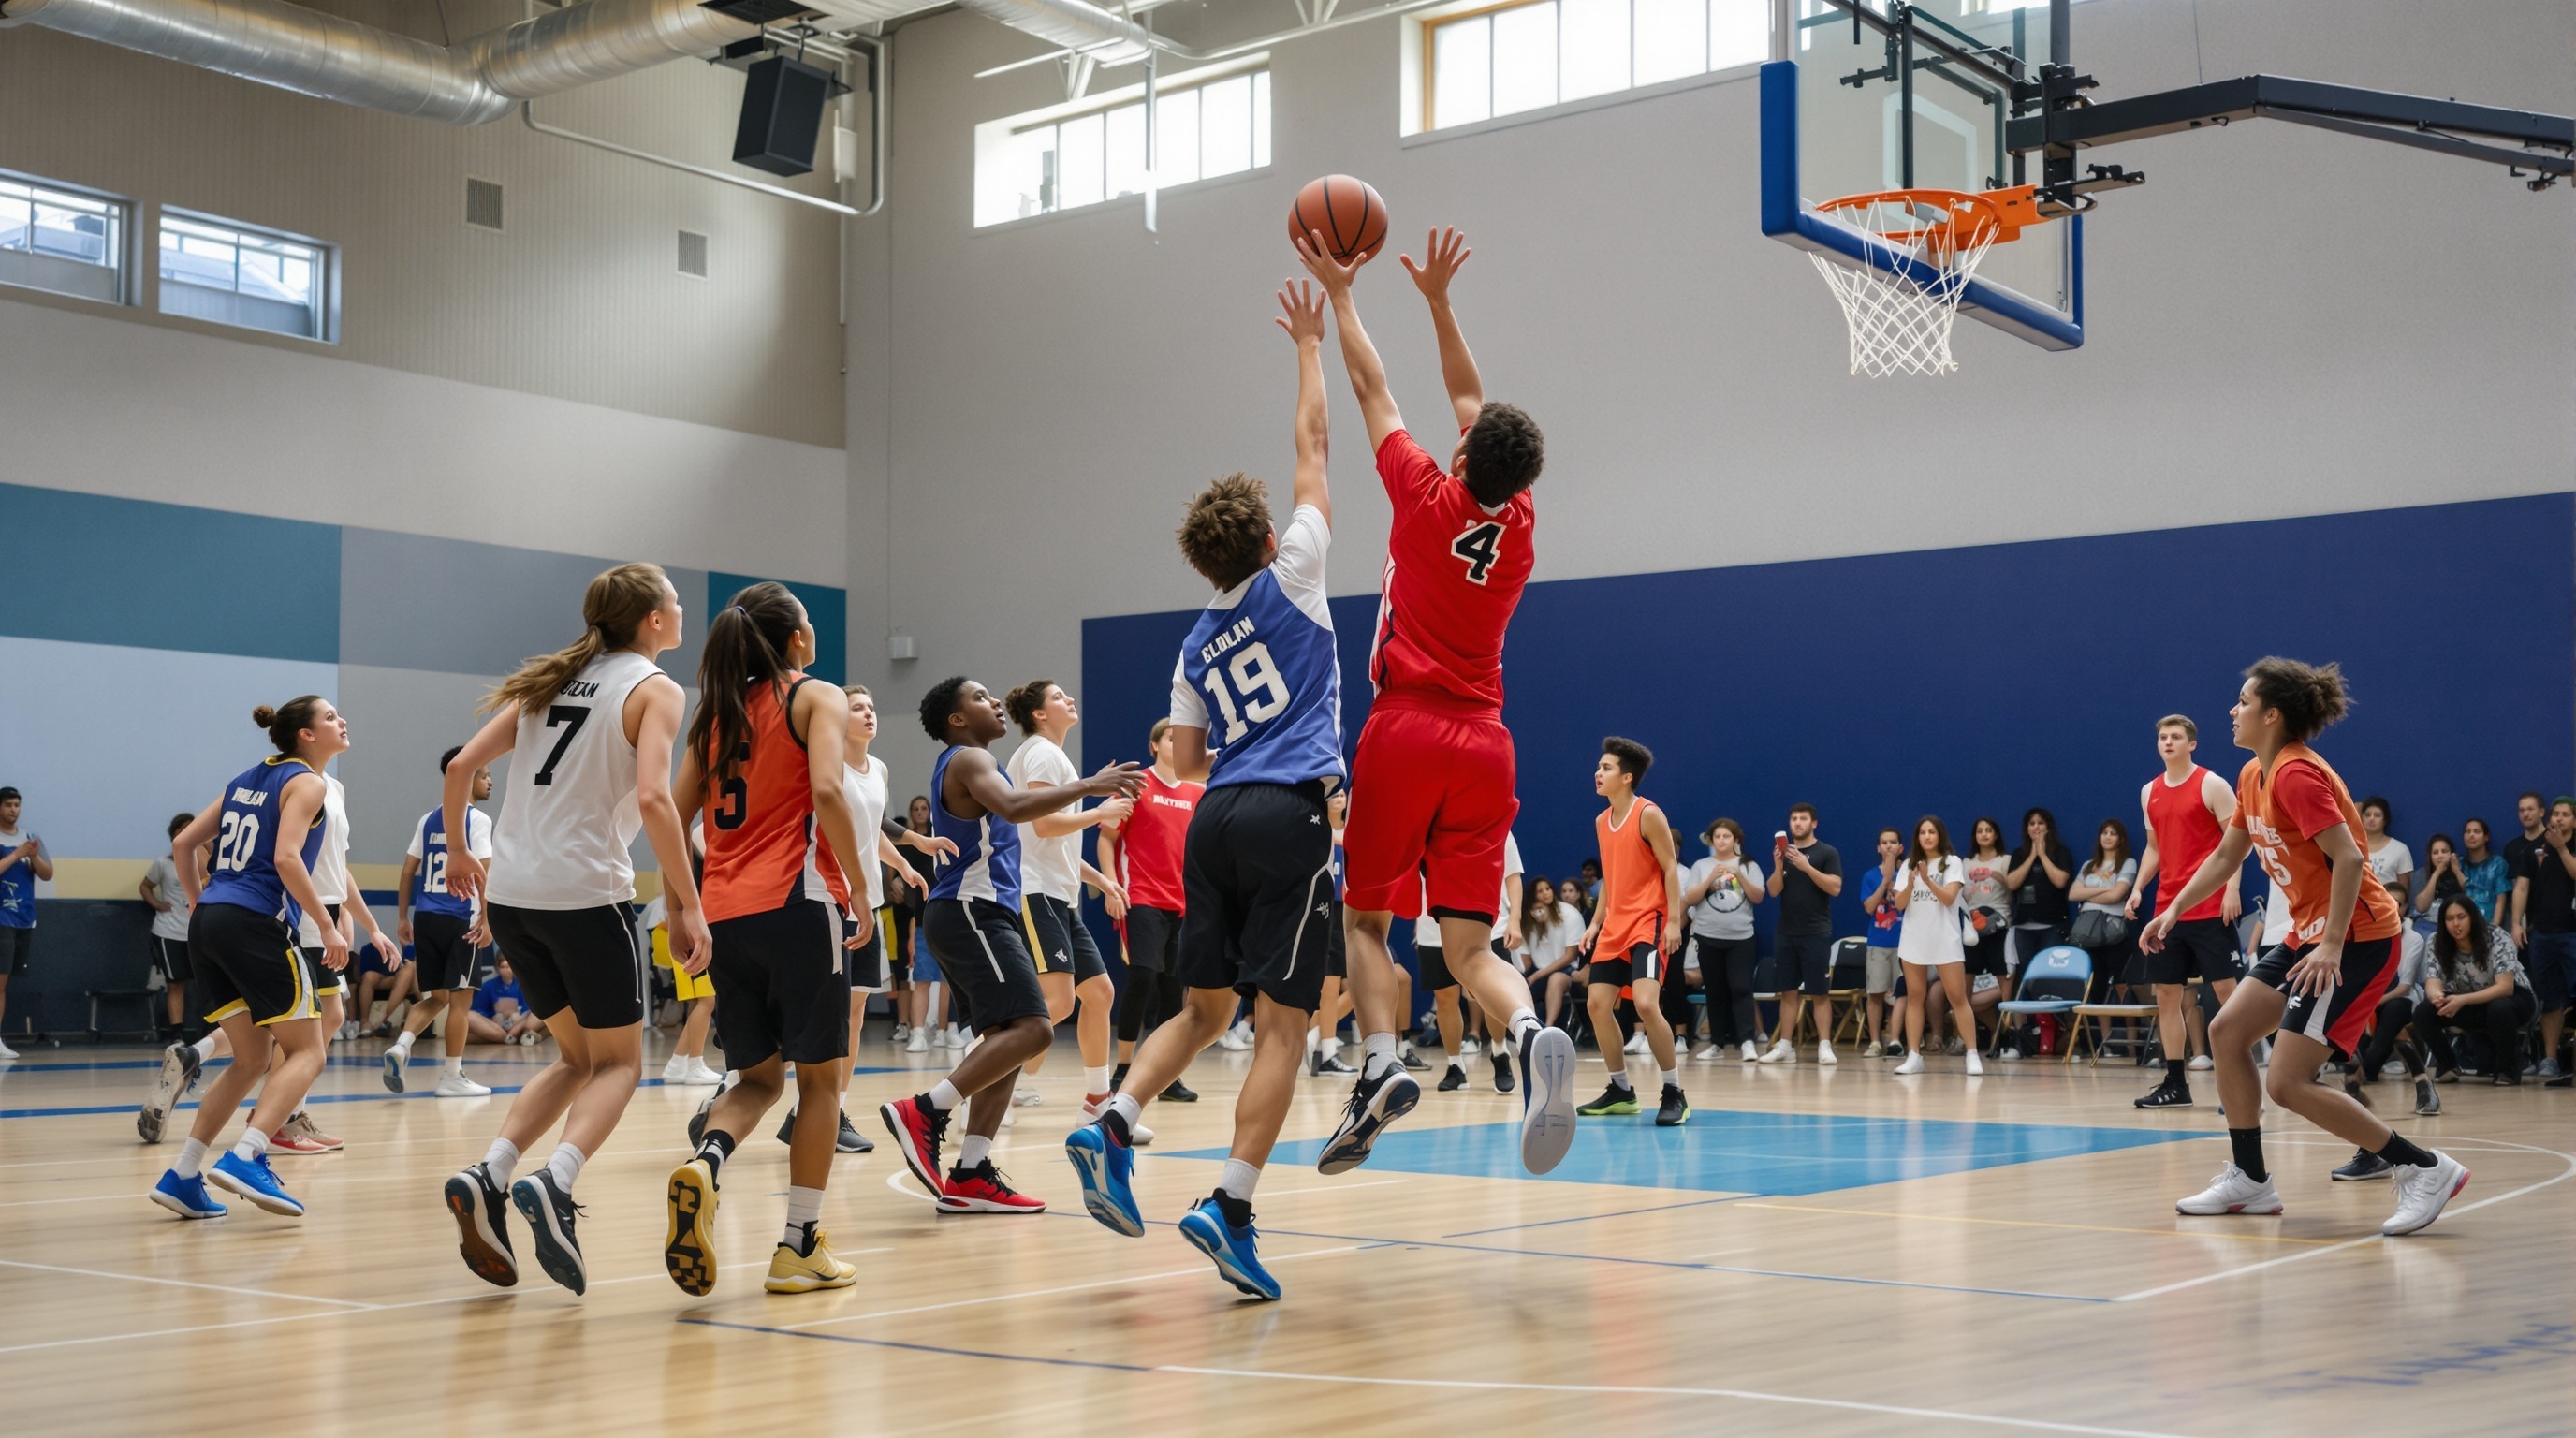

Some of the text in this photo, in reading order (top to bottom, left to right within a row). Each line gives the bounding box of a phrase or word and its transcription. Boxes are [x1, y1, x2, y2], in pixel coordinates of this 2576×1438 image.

[1451, 521, 1507, 586] 4
[1204, 641, 1291, 745] 19
[534, 705, 592, 786] 7
[216, 811, 260, 873] 20
[423, 851, 449, 894] 12
